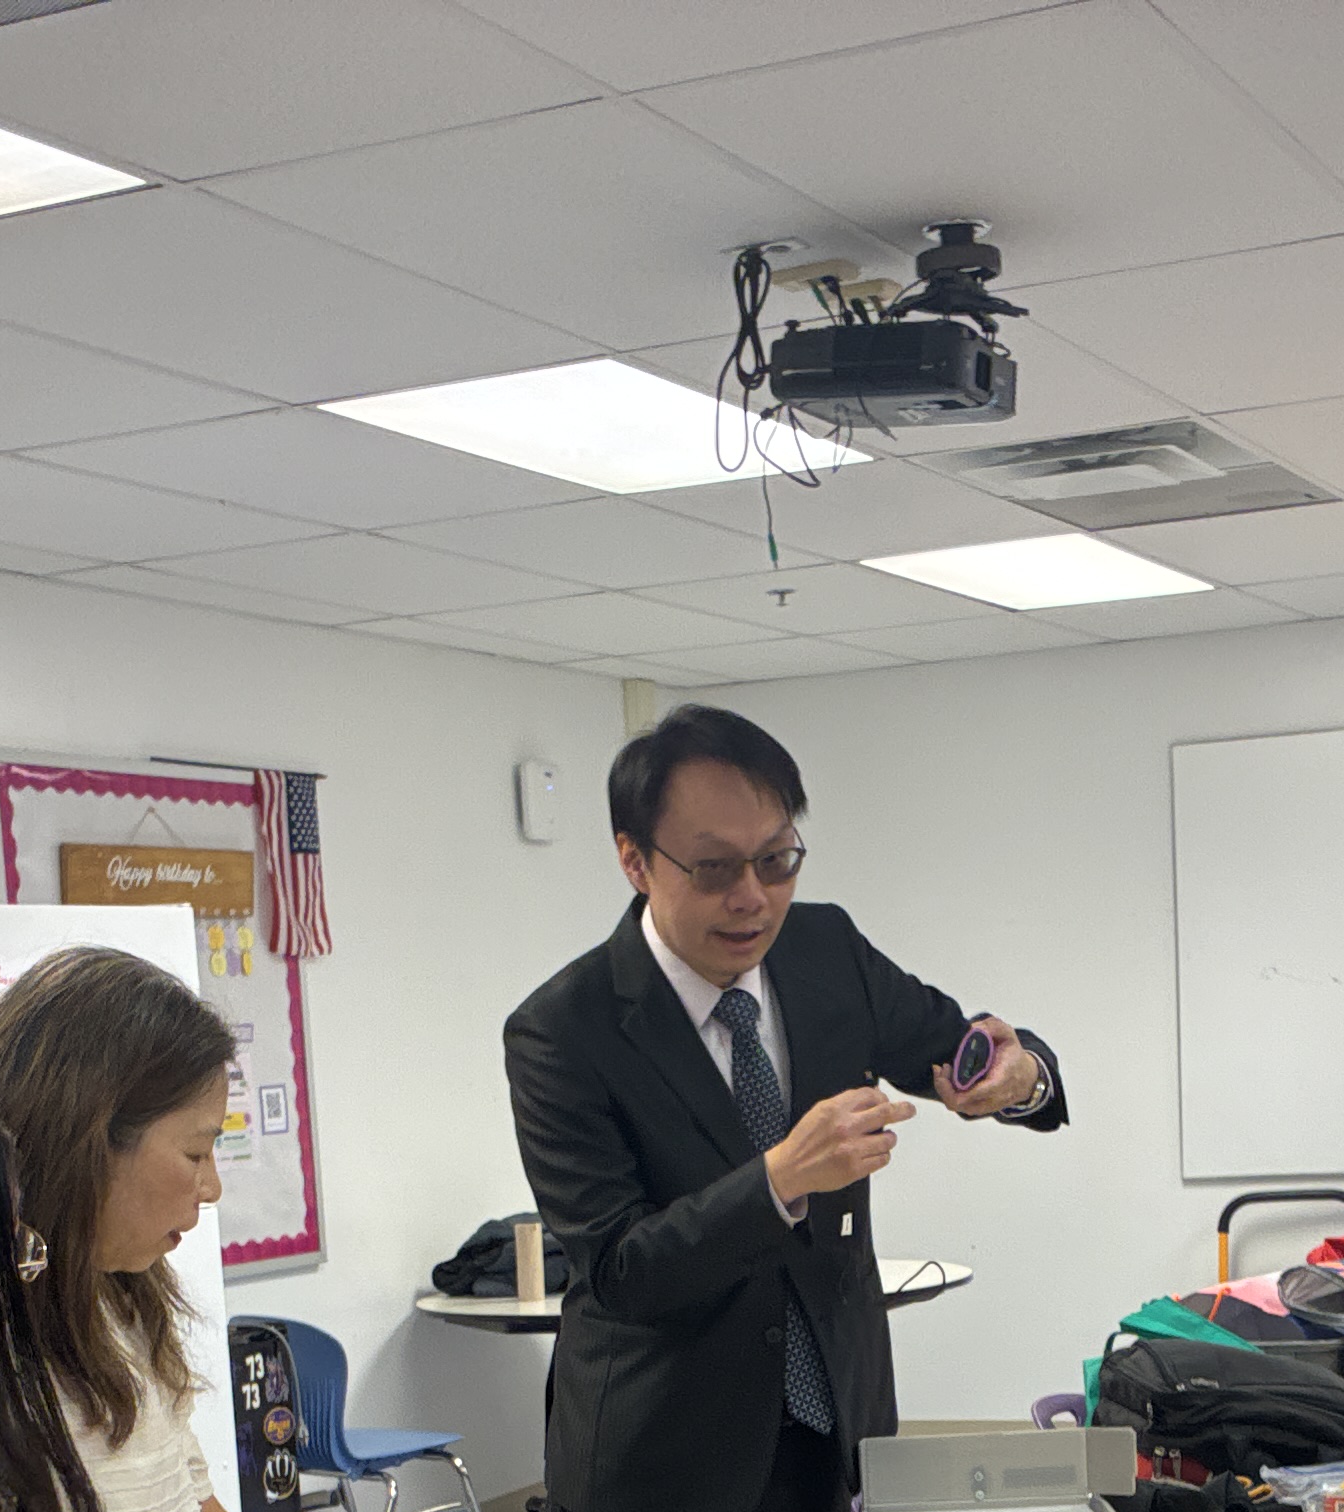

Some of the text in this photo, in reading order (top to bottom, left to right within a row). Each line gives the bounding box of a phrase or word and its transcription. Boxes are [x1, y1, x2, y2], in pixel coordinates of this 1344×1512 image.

[106, 855, 153, 891] Happy
[245, 1352, 265, 1381] 73
[241, 1382, 261, 1410] 73
